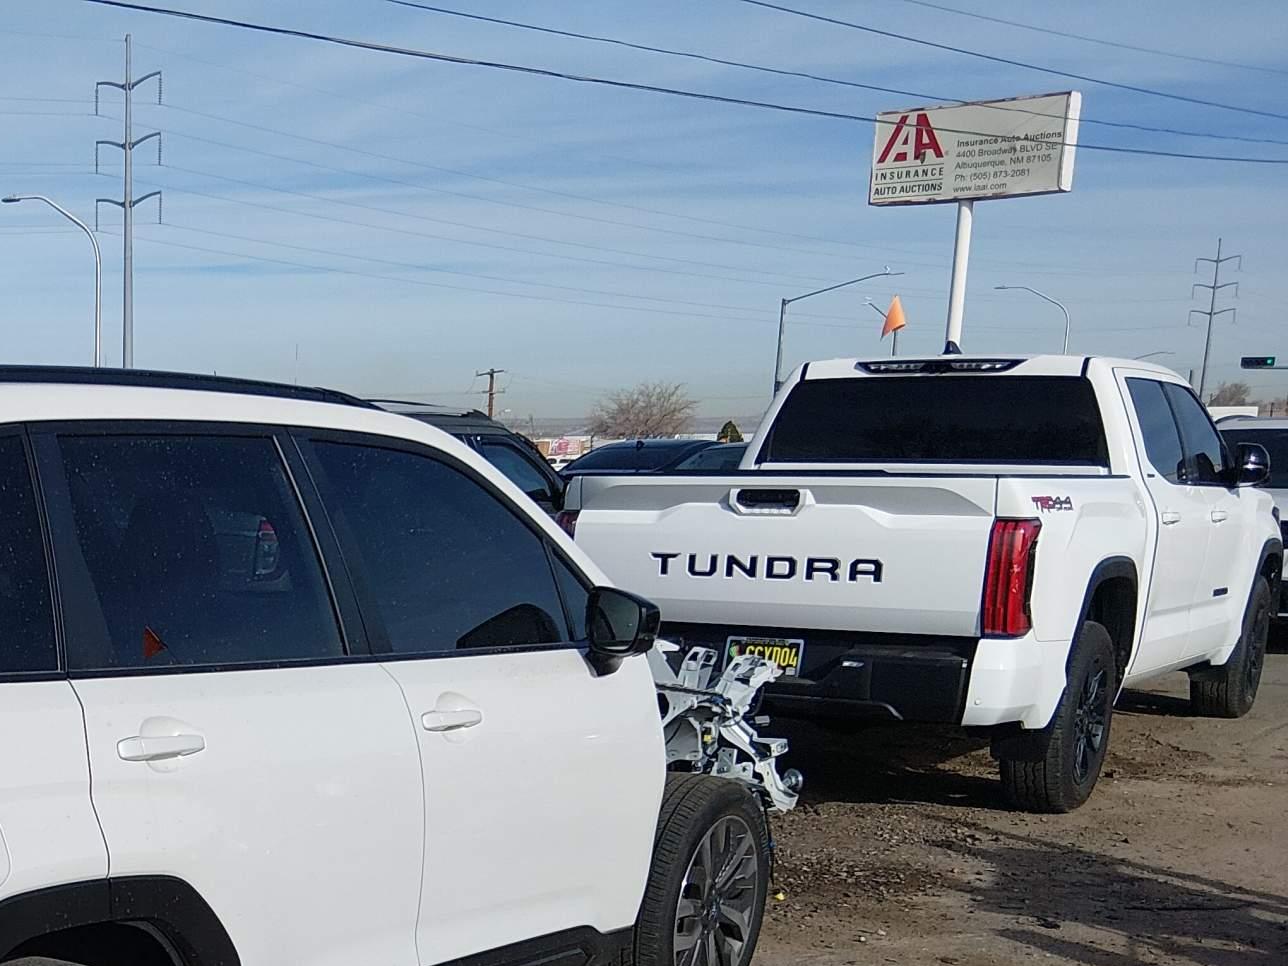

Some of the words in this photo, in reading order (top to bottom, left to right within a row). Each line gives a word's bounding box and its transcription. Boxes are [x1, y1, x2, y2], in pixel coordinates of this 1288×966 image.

[957, 137, 999, 148] Insurance
[956, 149, 976, 158] 4400
[978, 145, 1017, 157] Broadway
[1019, 144, 1043, 153] BLVD
[1045, 143, 1057, 151] SE
[1010, 157, 1024, 165] NM
[875, 167, 944, 181] INSURANCE
[873, 186, 897, 196] AUTO
[899, 182, 943, 194] AUCTIONS
[649, 551, 885, 584] TUNDRA
